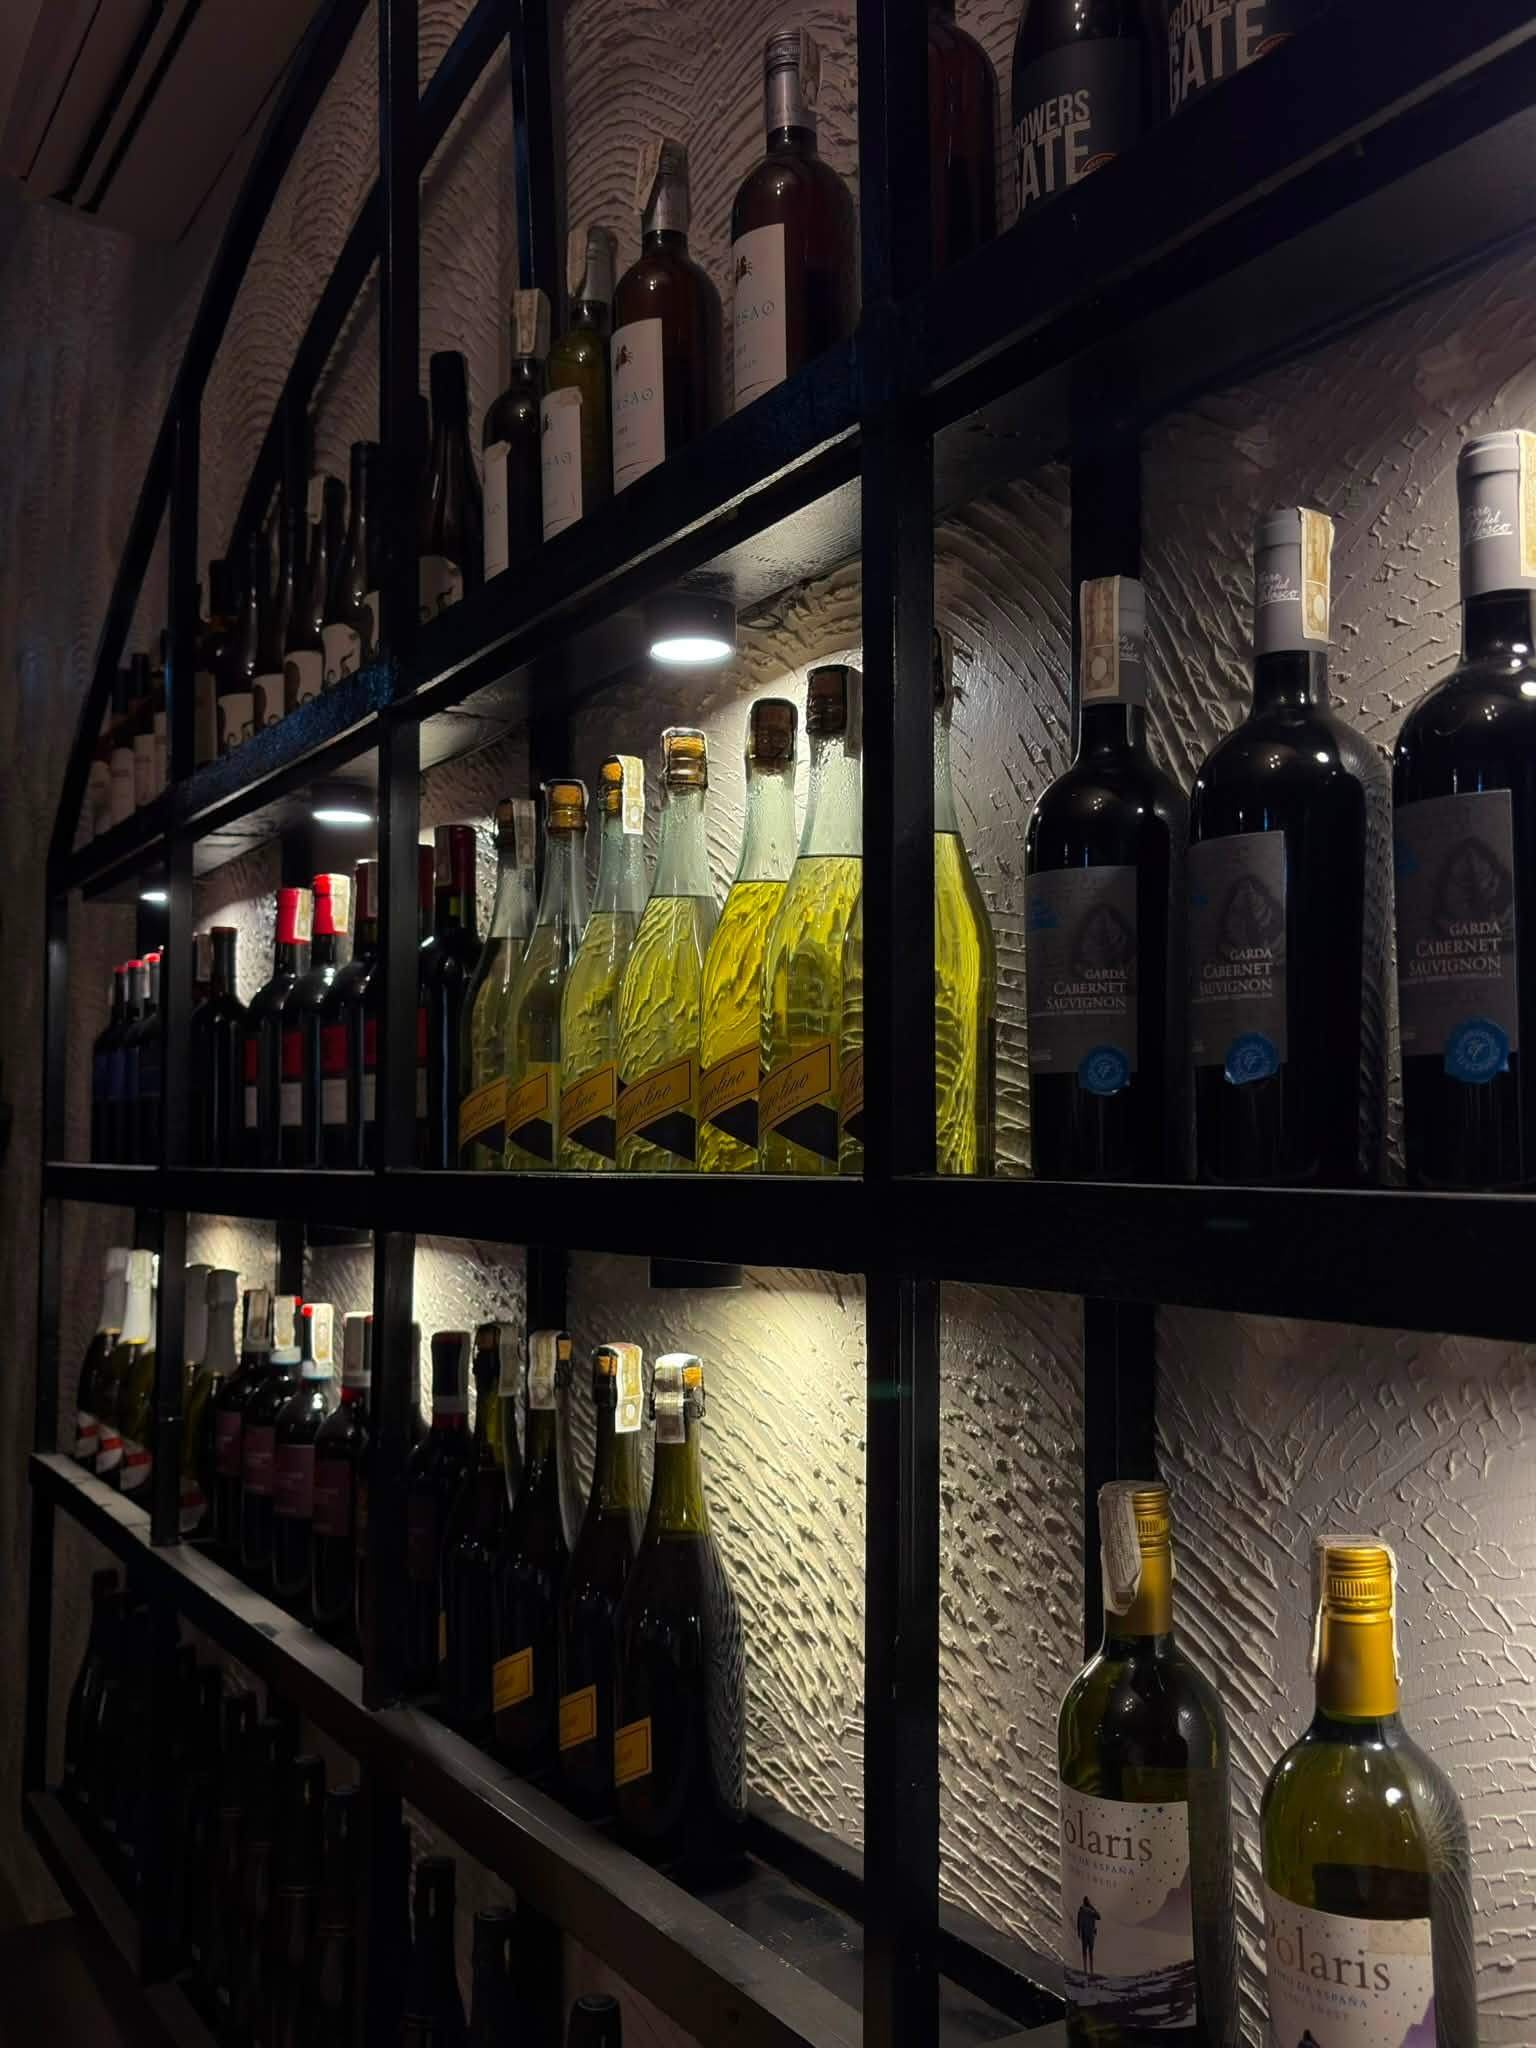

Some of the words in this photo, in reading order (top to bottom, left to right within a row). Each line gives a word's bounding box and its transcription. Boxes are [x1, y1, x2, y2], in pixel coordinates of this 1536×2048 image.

[1168, 0, 1266, 117] GATE
[1449, 920, 1503, 937] GARDA
[1229, 947, 1273, 961] GARDA
[1416, 937, 1503, 958] CABERNET
[1085, 967, 1128, 980] GARDA
[1203, 961, 1274, 978] CABERNET
[1408, 955, 1503, 976] SAUVIGNON
[1053, 981, 1128, 996] CABERNET
[1046, 995, 1128, 1010] SAUVIGNON
[1062, 1806, 1153, 1863] olaris
